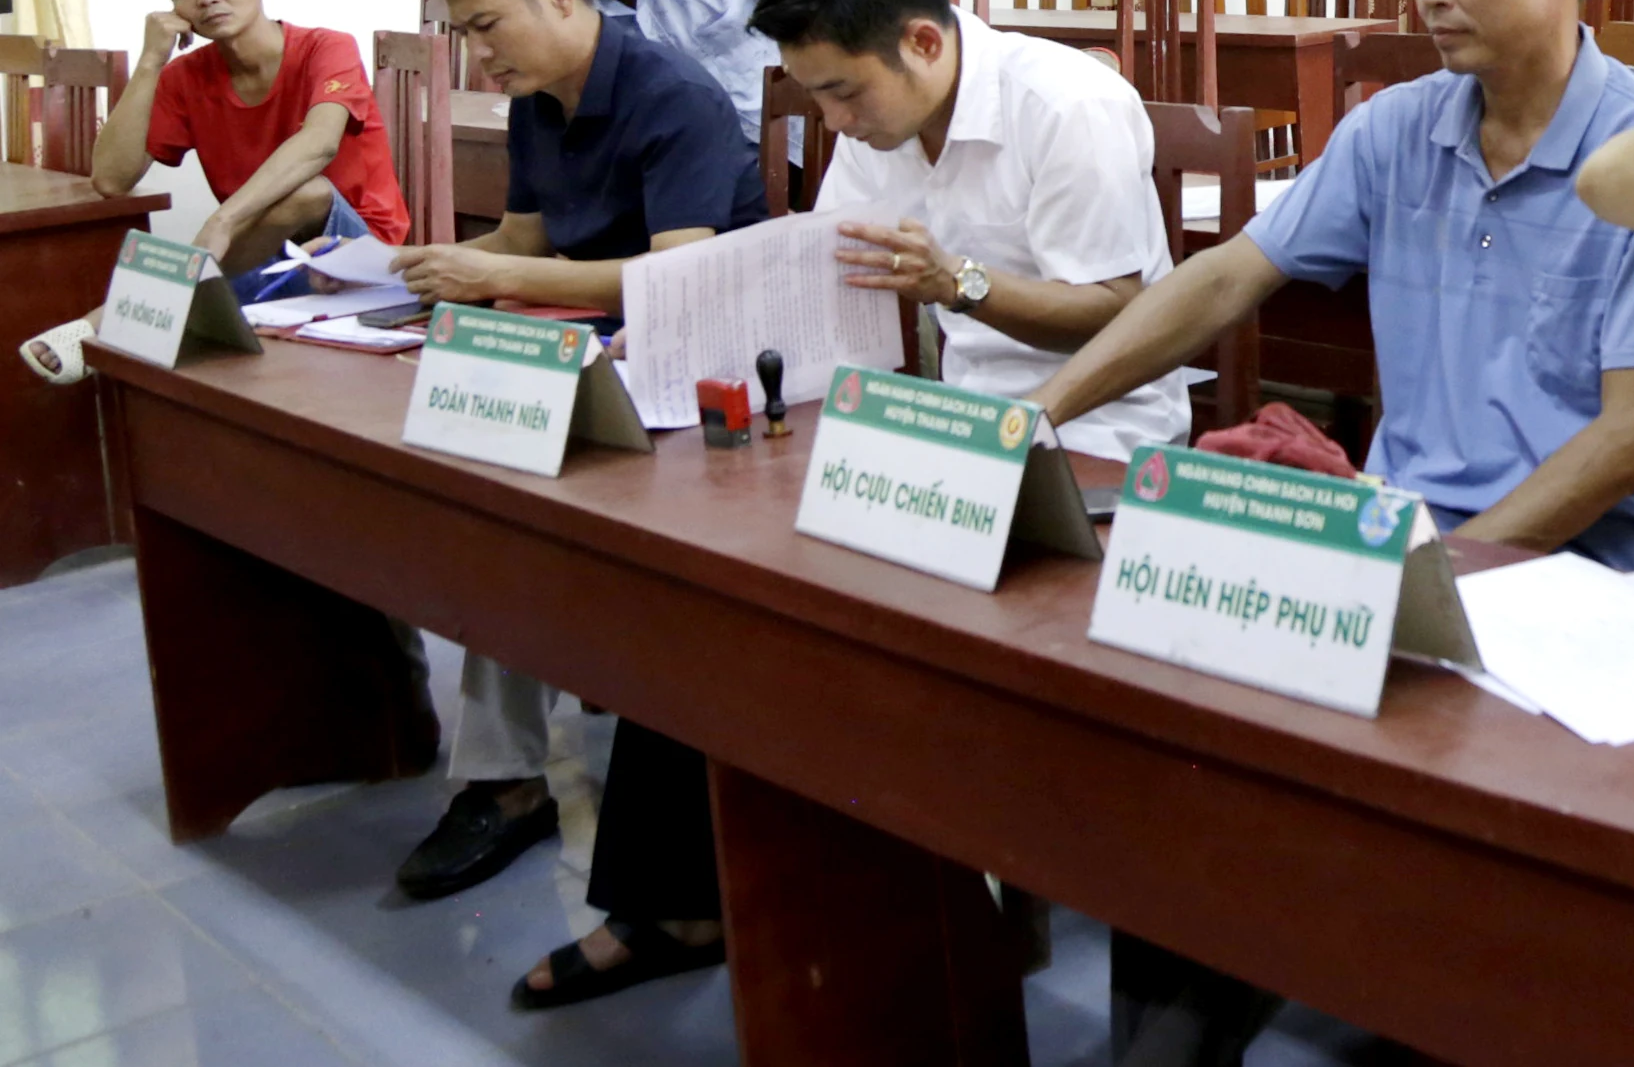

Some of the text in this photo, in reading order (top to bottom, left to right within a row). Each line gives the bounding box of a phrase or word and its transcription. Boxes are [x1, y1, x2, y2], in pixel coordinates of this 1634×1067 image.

[428, 384, 552, 432] ĐOÀN THANH NIÊN
[820, 458, 998, 535] HỘI CỰU CHIẾN BINH
[1116, 554, 1375, 648] HỘI LIÊN HIỆP PHỤ NỮ
